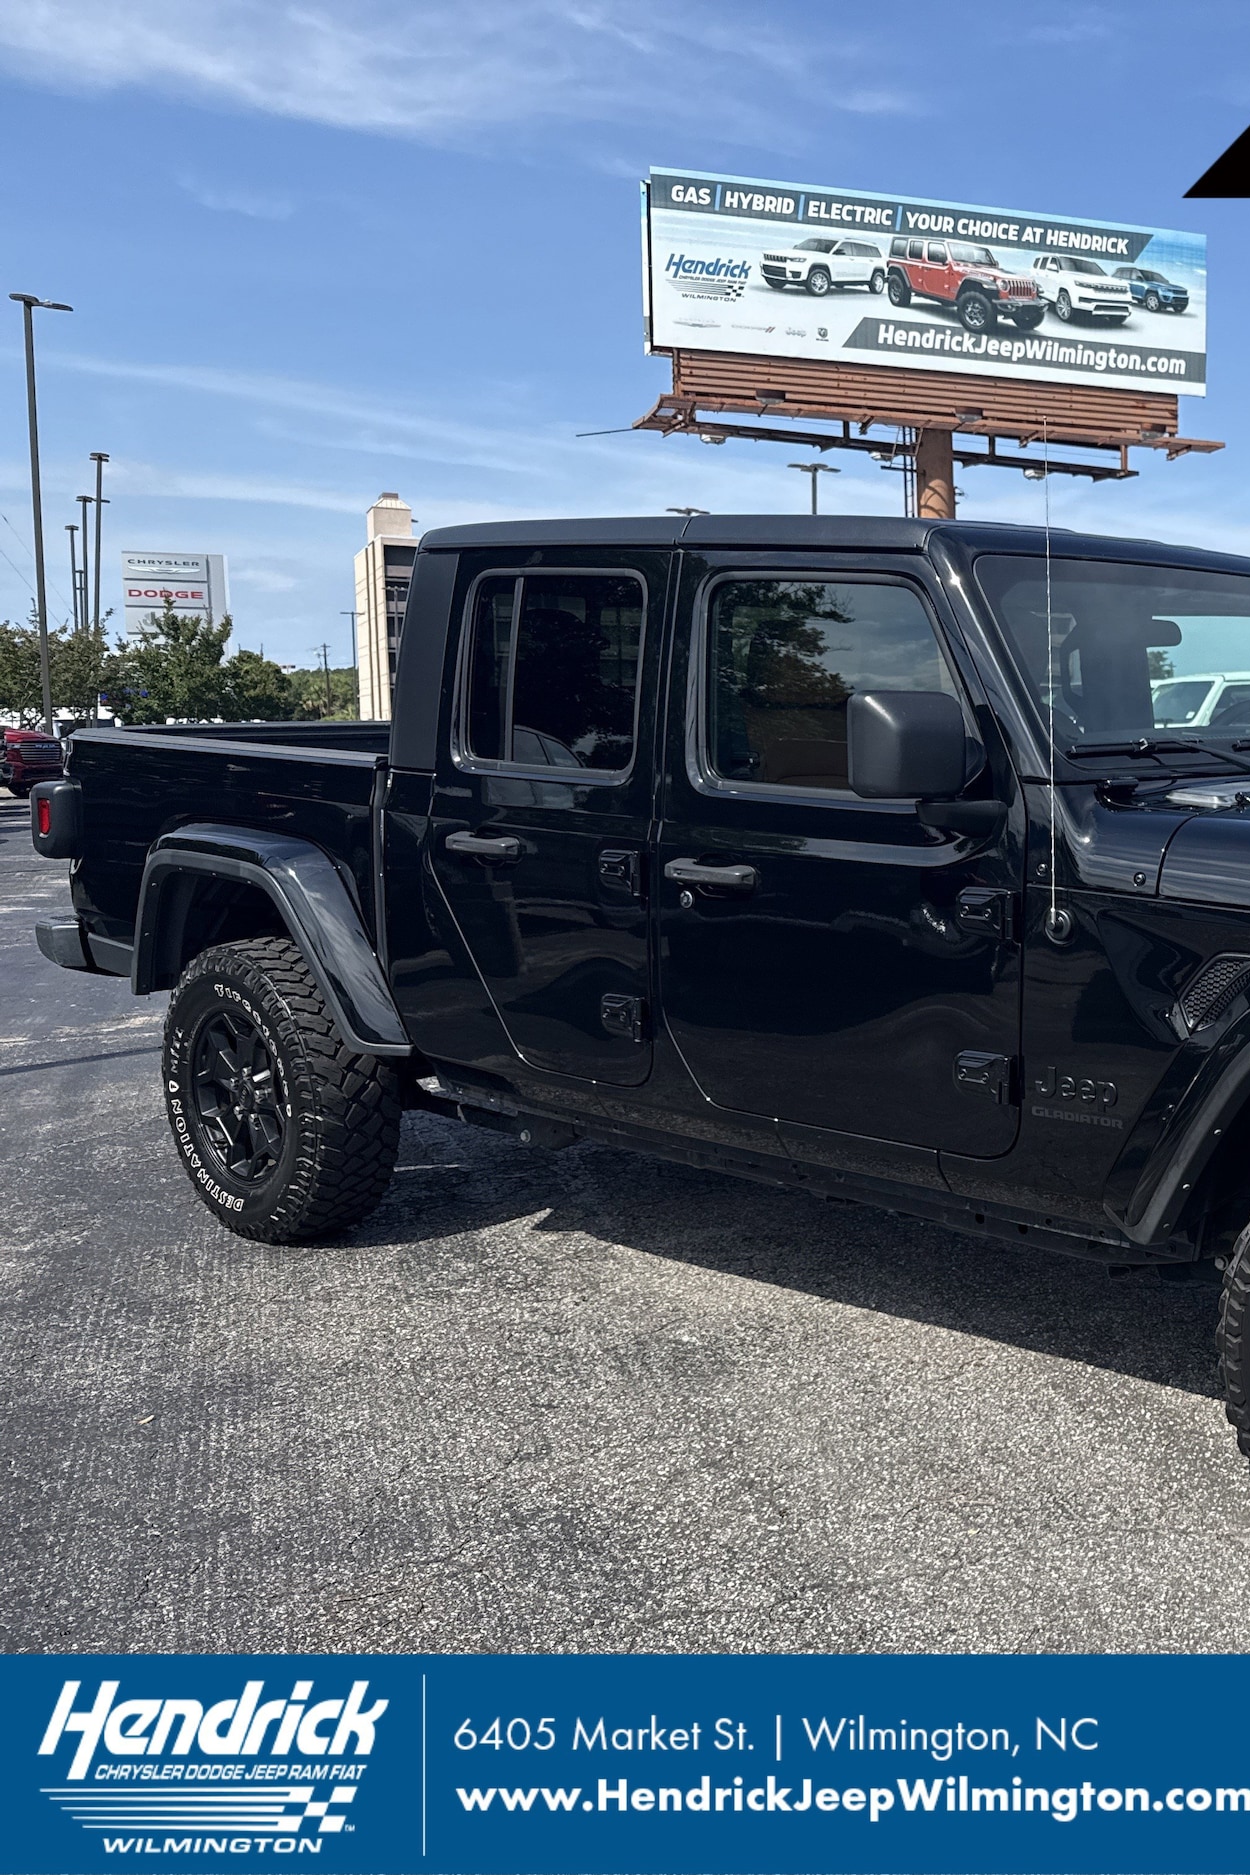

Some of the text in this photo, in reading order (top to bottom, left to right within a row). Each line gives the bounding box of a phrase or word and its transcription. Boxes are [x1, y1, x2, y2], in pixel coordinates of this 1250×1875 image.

[671, 185, 1129, 255] GAS HYBRID ELECTRIC YOUR CHOICE AT HENDRICK
[664, 253, 752, 280] Hendrick
[681, 293, 737, 303] WILMINGTON
[877, 324, 1187, 376] HendrickJeepWilmington.com
[127, 558, 200, 567] CHRYSLER
[127, 589, 204, 600] DODGE
[1035, 1066, 1119, 1113] Jeep
[1031, 1105, 1124, 1130] GLADIATOR
[171, 1099, 244, 1212] DESTINATION
